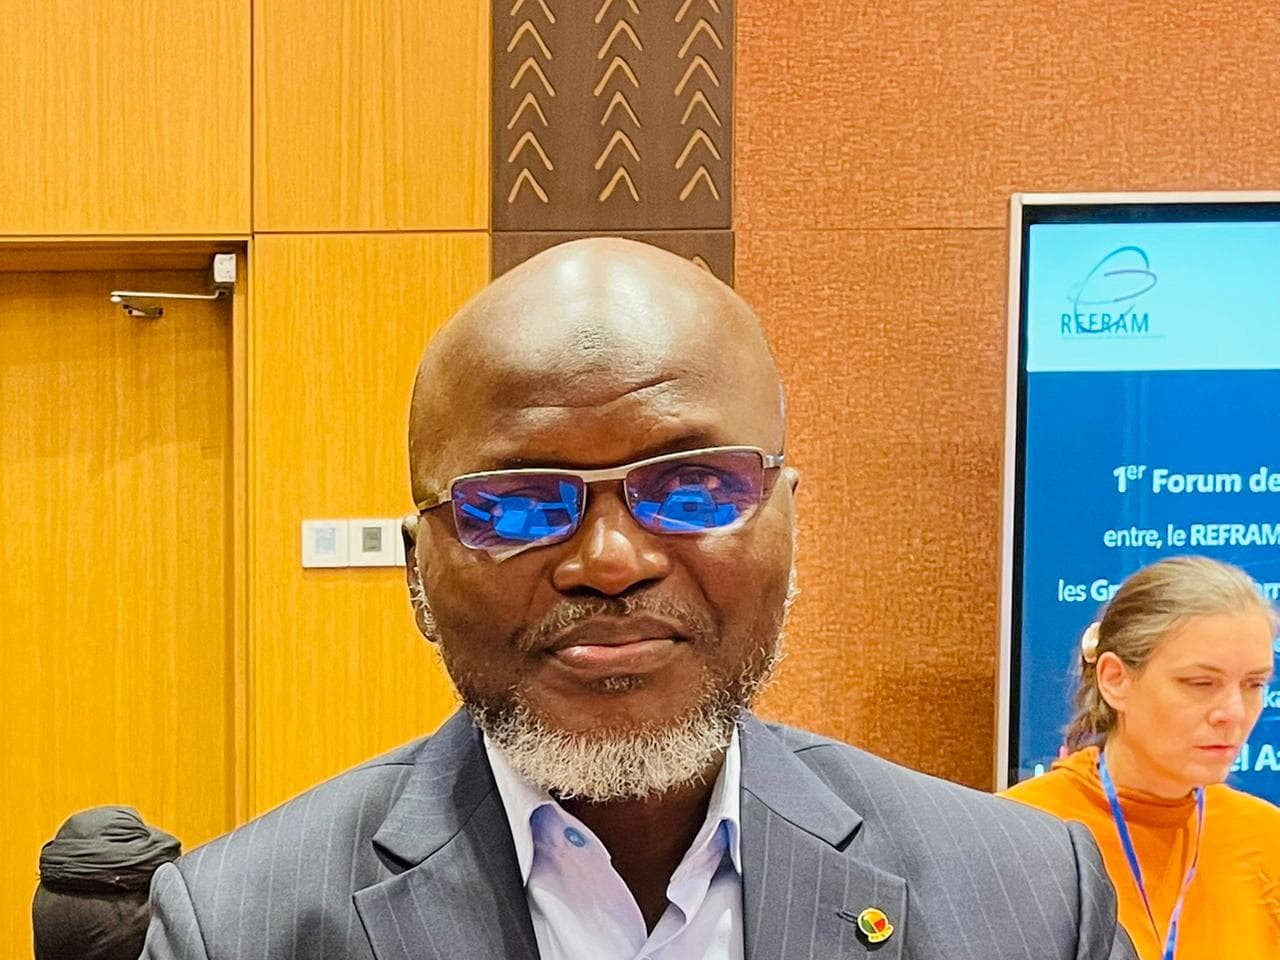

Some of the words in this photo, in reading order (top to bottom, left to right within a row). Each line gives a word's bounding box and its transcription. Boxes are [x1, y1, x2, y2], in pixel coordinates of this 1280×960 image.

[1061, 313, 1149, 334] REFRAM
[1113, 465, 1147, 493] 1er
[1152, 469, 1242, 493] Forum
[1103, 527, 1163, 549] entre,
[1167, 523, 1187, 546] le
[1058, 579, 1087, 602] les
